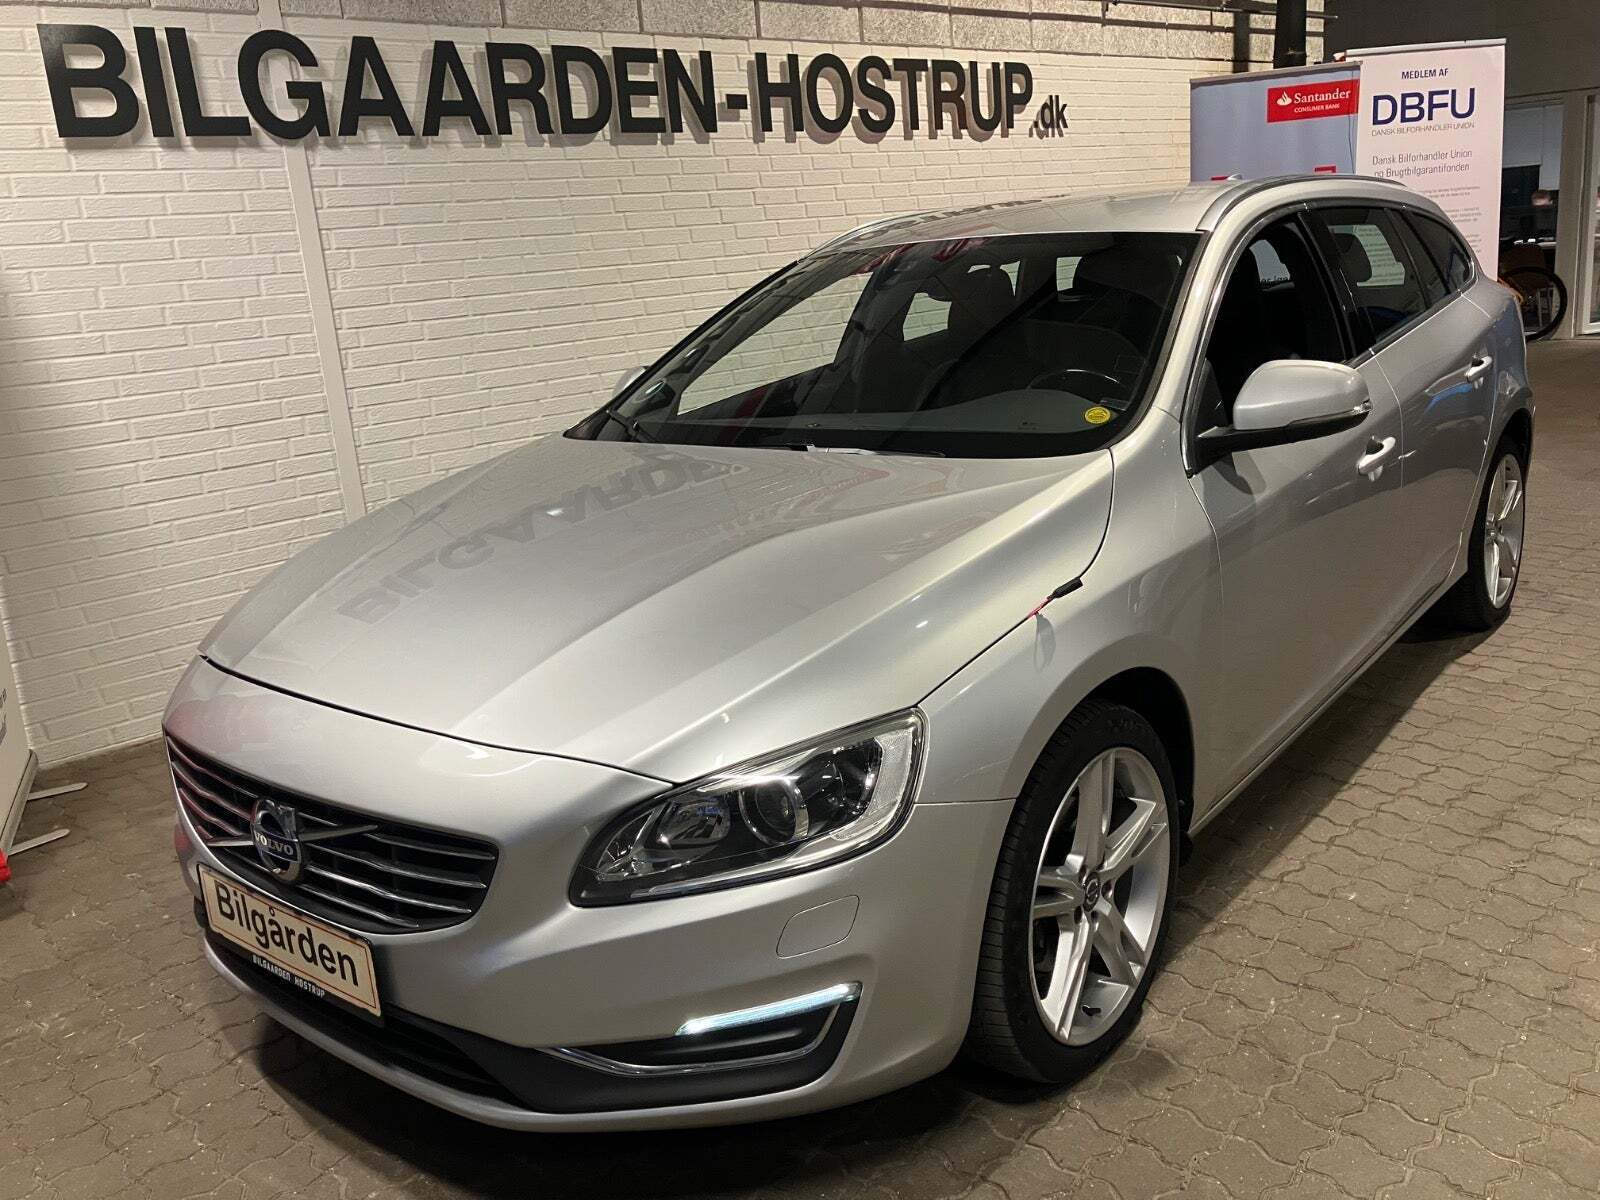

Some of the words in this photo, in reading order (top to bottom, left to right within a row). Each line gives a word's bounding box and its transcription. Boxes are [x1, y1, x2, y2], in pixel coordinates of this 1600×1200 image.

[1401, 69, 1436, 79] MEDLEM
[1438, 68, 1449, 77] AF
[1294, 88, 1351, 104] Santander
[1294, 105, 1324, 113] CONSUMER
[1372, 87, 1475, 126] DBFU
[1371, 127, 1396, 137] DANSK
[1396, 124, 1453, 135] BILFORHANDLER
[1454, 122, 1475, 131] UNION
[1372, 155, 1396, 166] Dansk
[1398, 150, 1448, 164] Bilforhandler
[1450, 149, 1473, 159] Union
[1386, 163, 1470, 178] Brugtbilgarantifonden
[253, 830, 294, 856] VOLVO
[214, 879, 359, 987] Bilgården
[252, 954, 291, 982] BILGAARDEN
[294, 976, 325, 998] HOSTRUP
